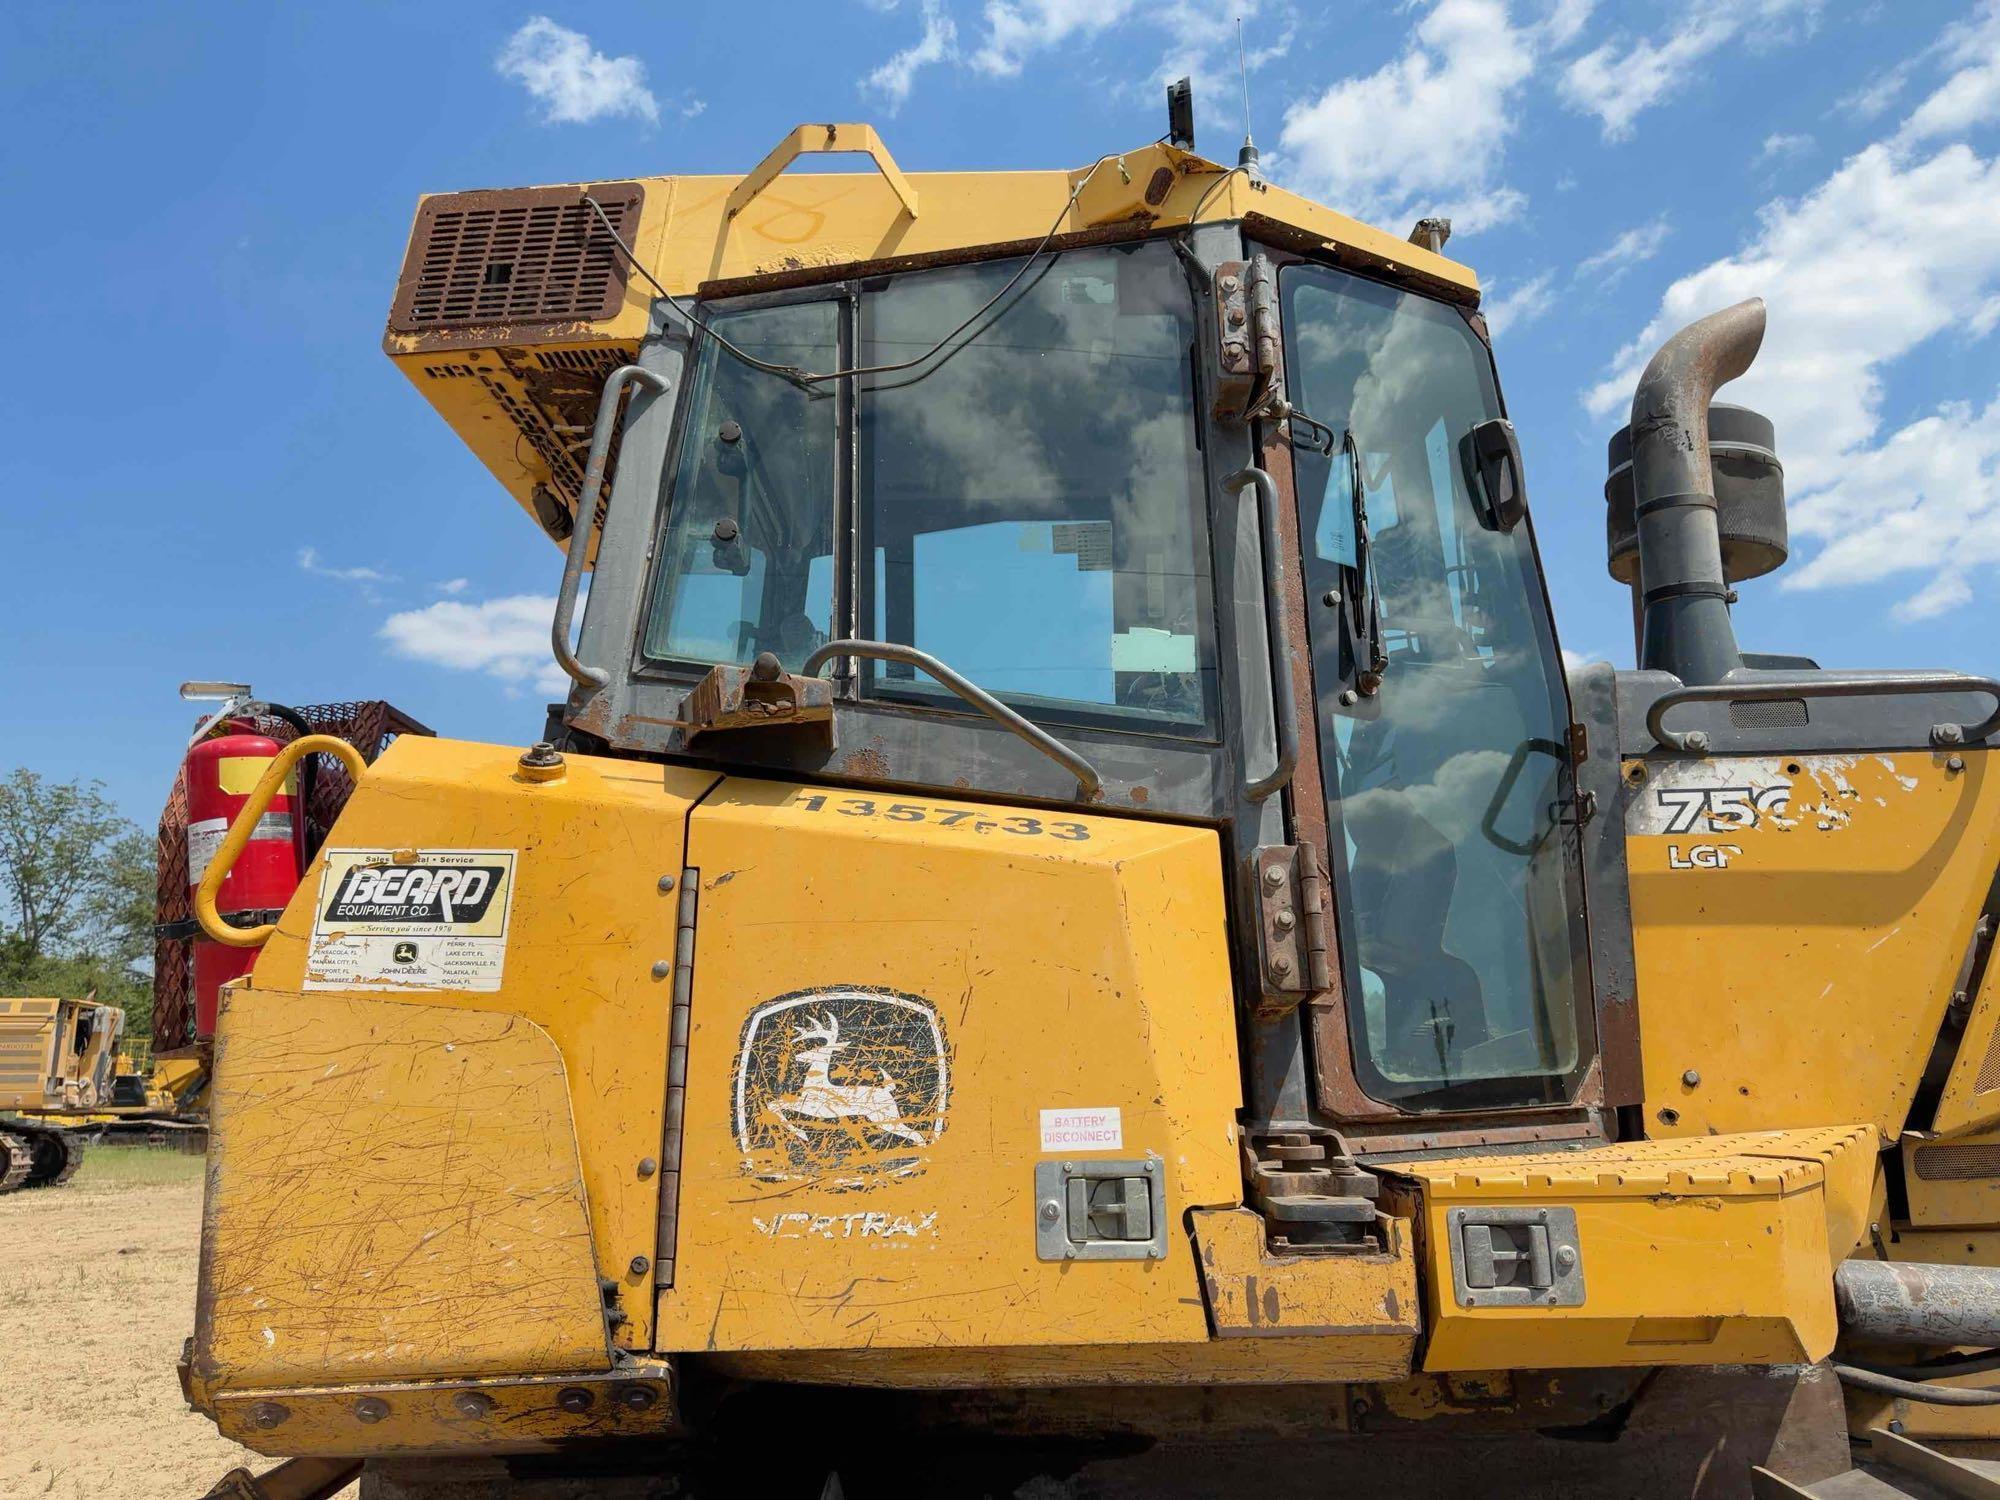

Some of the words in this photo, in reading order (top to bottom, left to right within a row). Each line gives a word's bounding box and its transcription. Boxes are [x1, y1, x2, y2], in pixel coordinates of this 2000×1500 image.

[365, 855, 390, 863] Sales
[340, 869, 490, 922] BEARD
[337, 904, 409, 916] EQUIPMENT
[402, 967, 427, 975] DEERE
[1054, 1115, 1106, 1127] BATTERY
[1044, 1130, 1119, 1143] DISCONNECT
